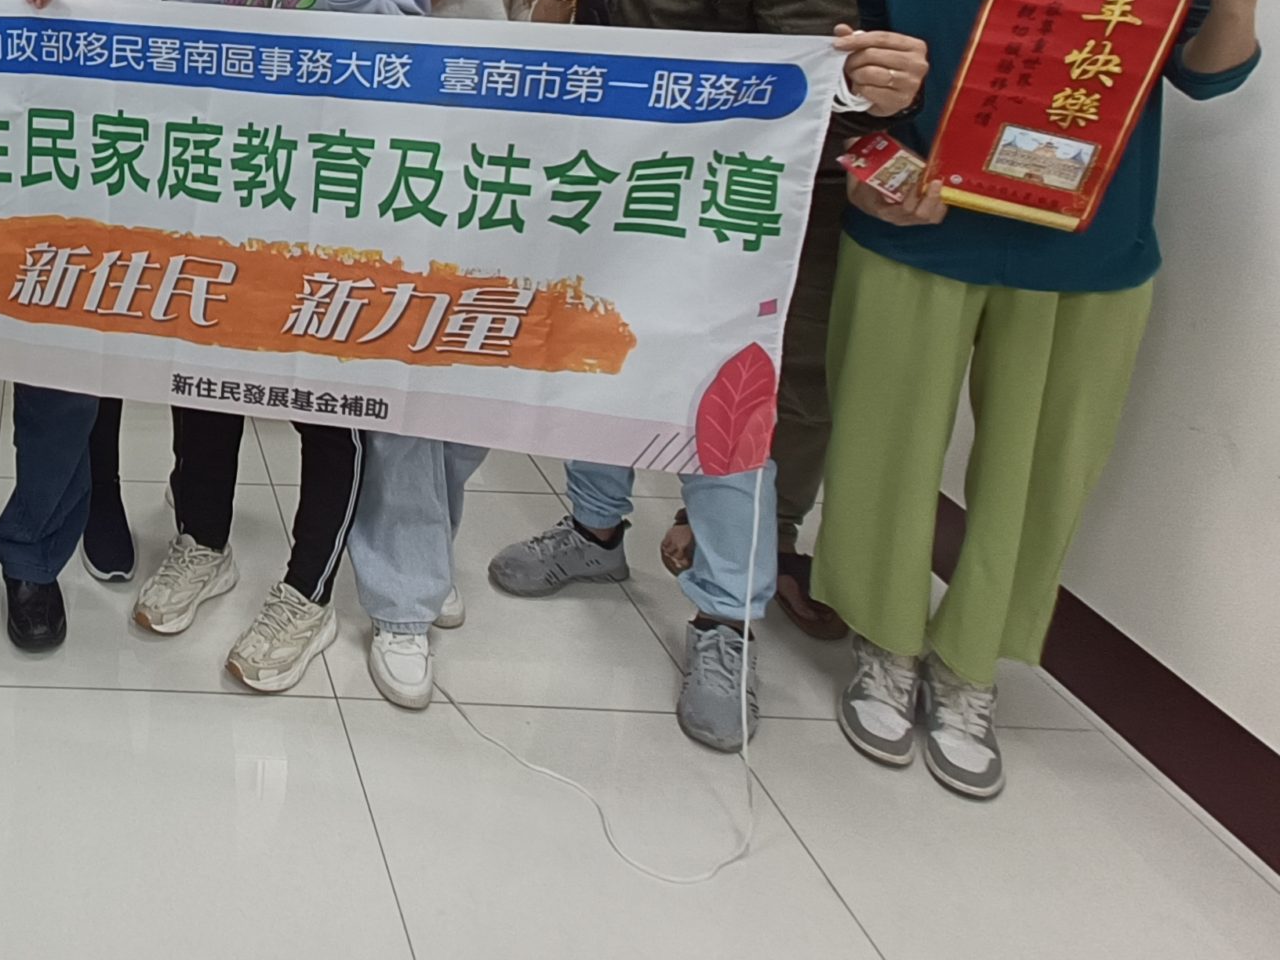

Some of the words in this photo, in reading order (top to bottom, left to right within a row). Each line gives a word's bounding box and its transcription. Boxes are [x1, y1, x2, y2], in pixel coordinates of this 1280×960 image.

[438, 57, 779, 112] 臺南市第一服務站
[7, 241, 238, 328] 新住民
[280, 271, 538, 357] 新力量
[171, 372, 390, 421] 新住民發展基金補助
